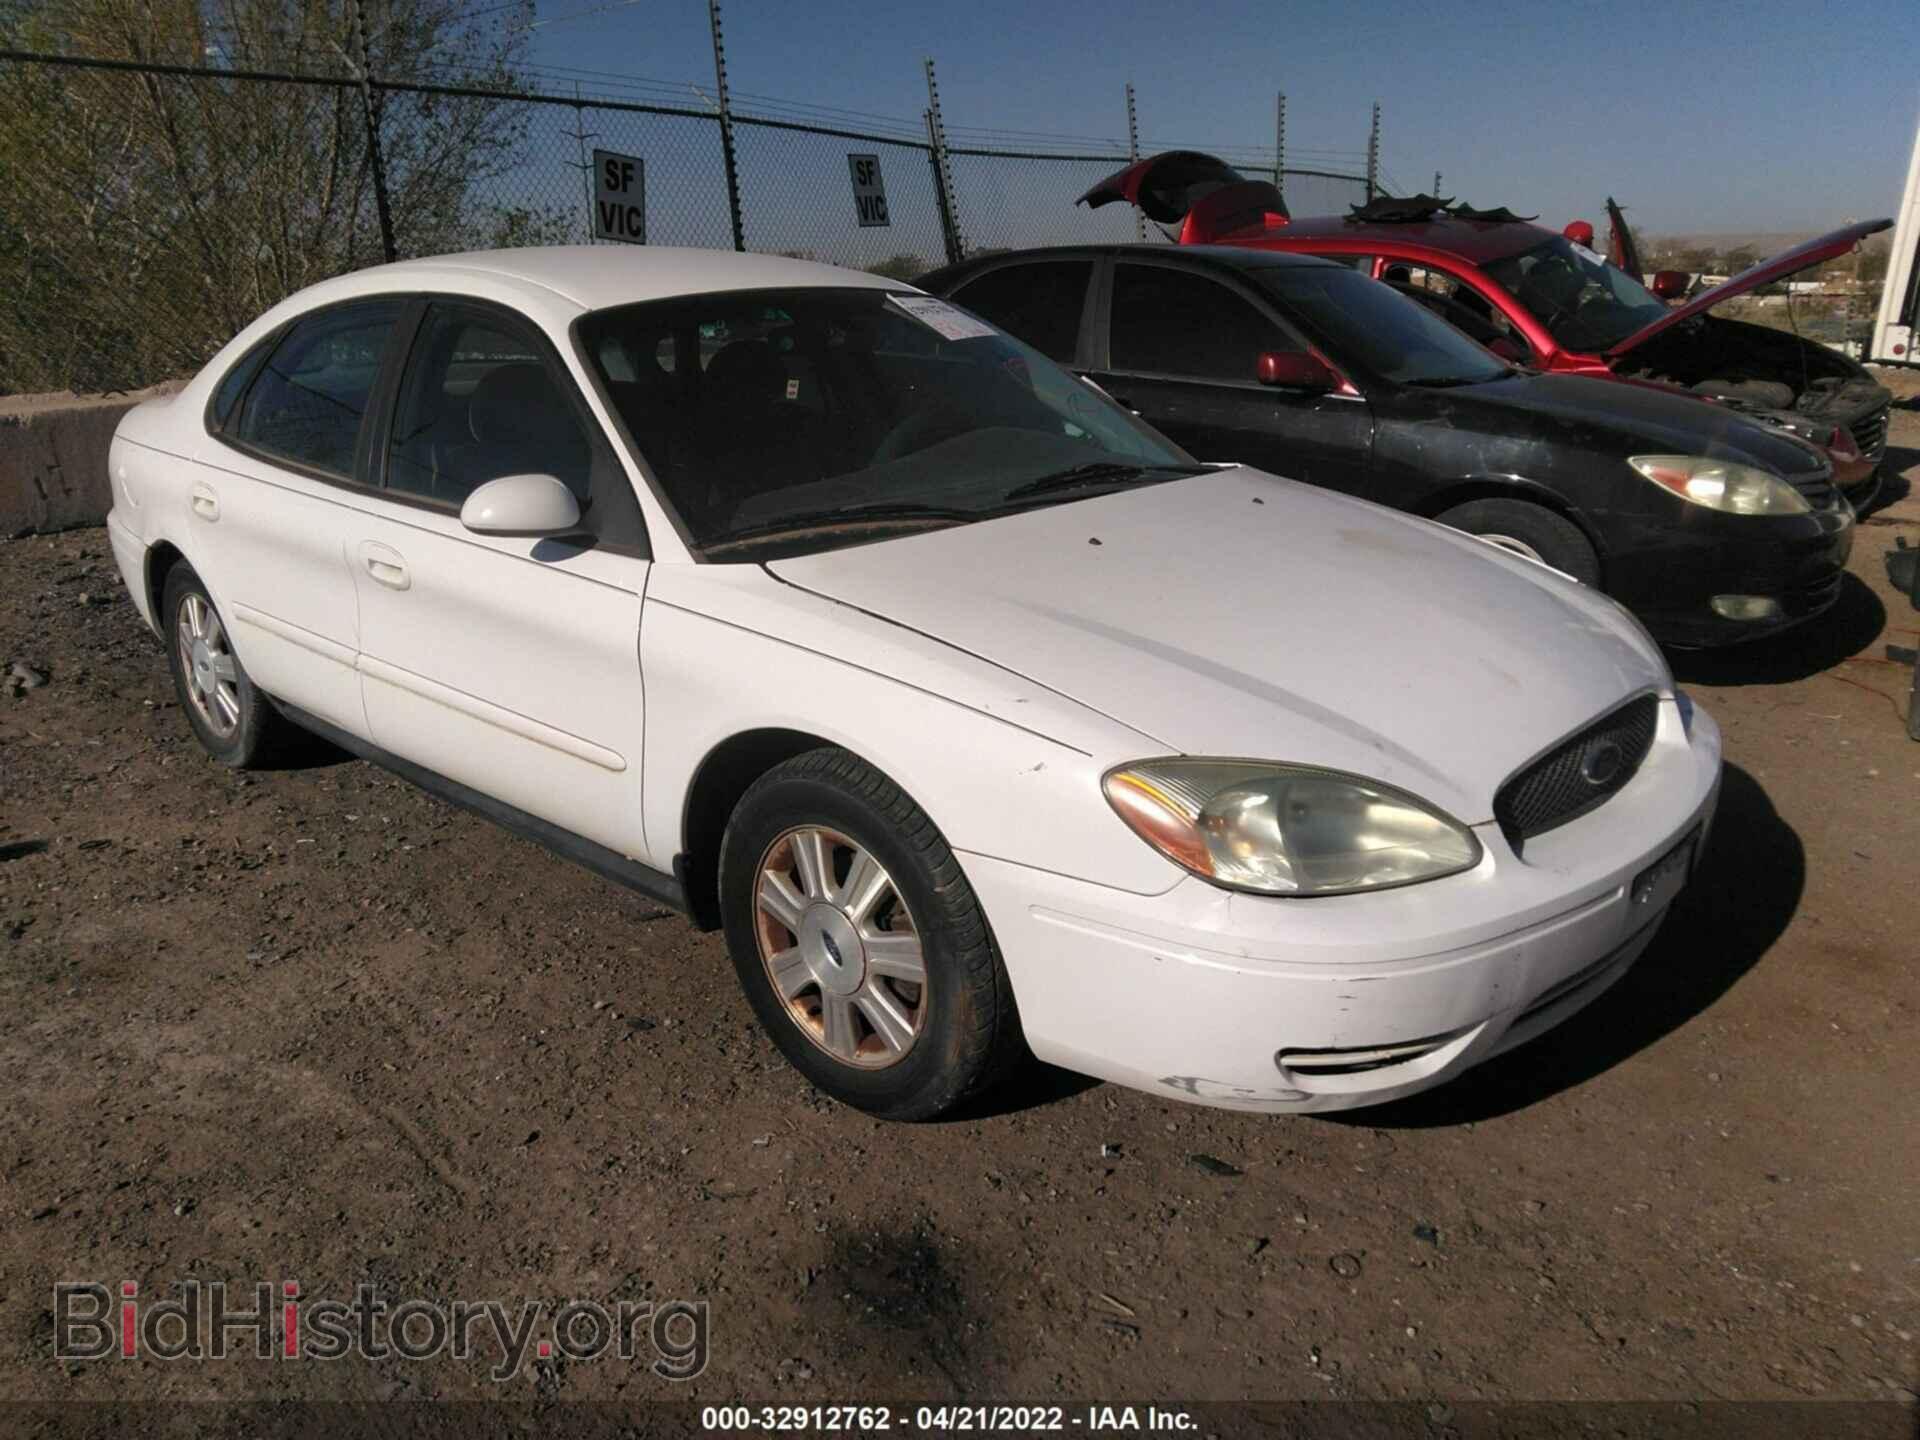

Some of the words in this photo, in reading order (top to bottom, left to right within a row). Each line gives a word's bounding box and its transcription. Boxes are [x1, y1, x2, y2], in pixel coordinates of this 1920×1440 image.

[605, 158, 635, 193] SF
[855, 160, 874, 187] SF
[599, 201, 643, 237] VIC
[857, 194, 886, 221] VIC
